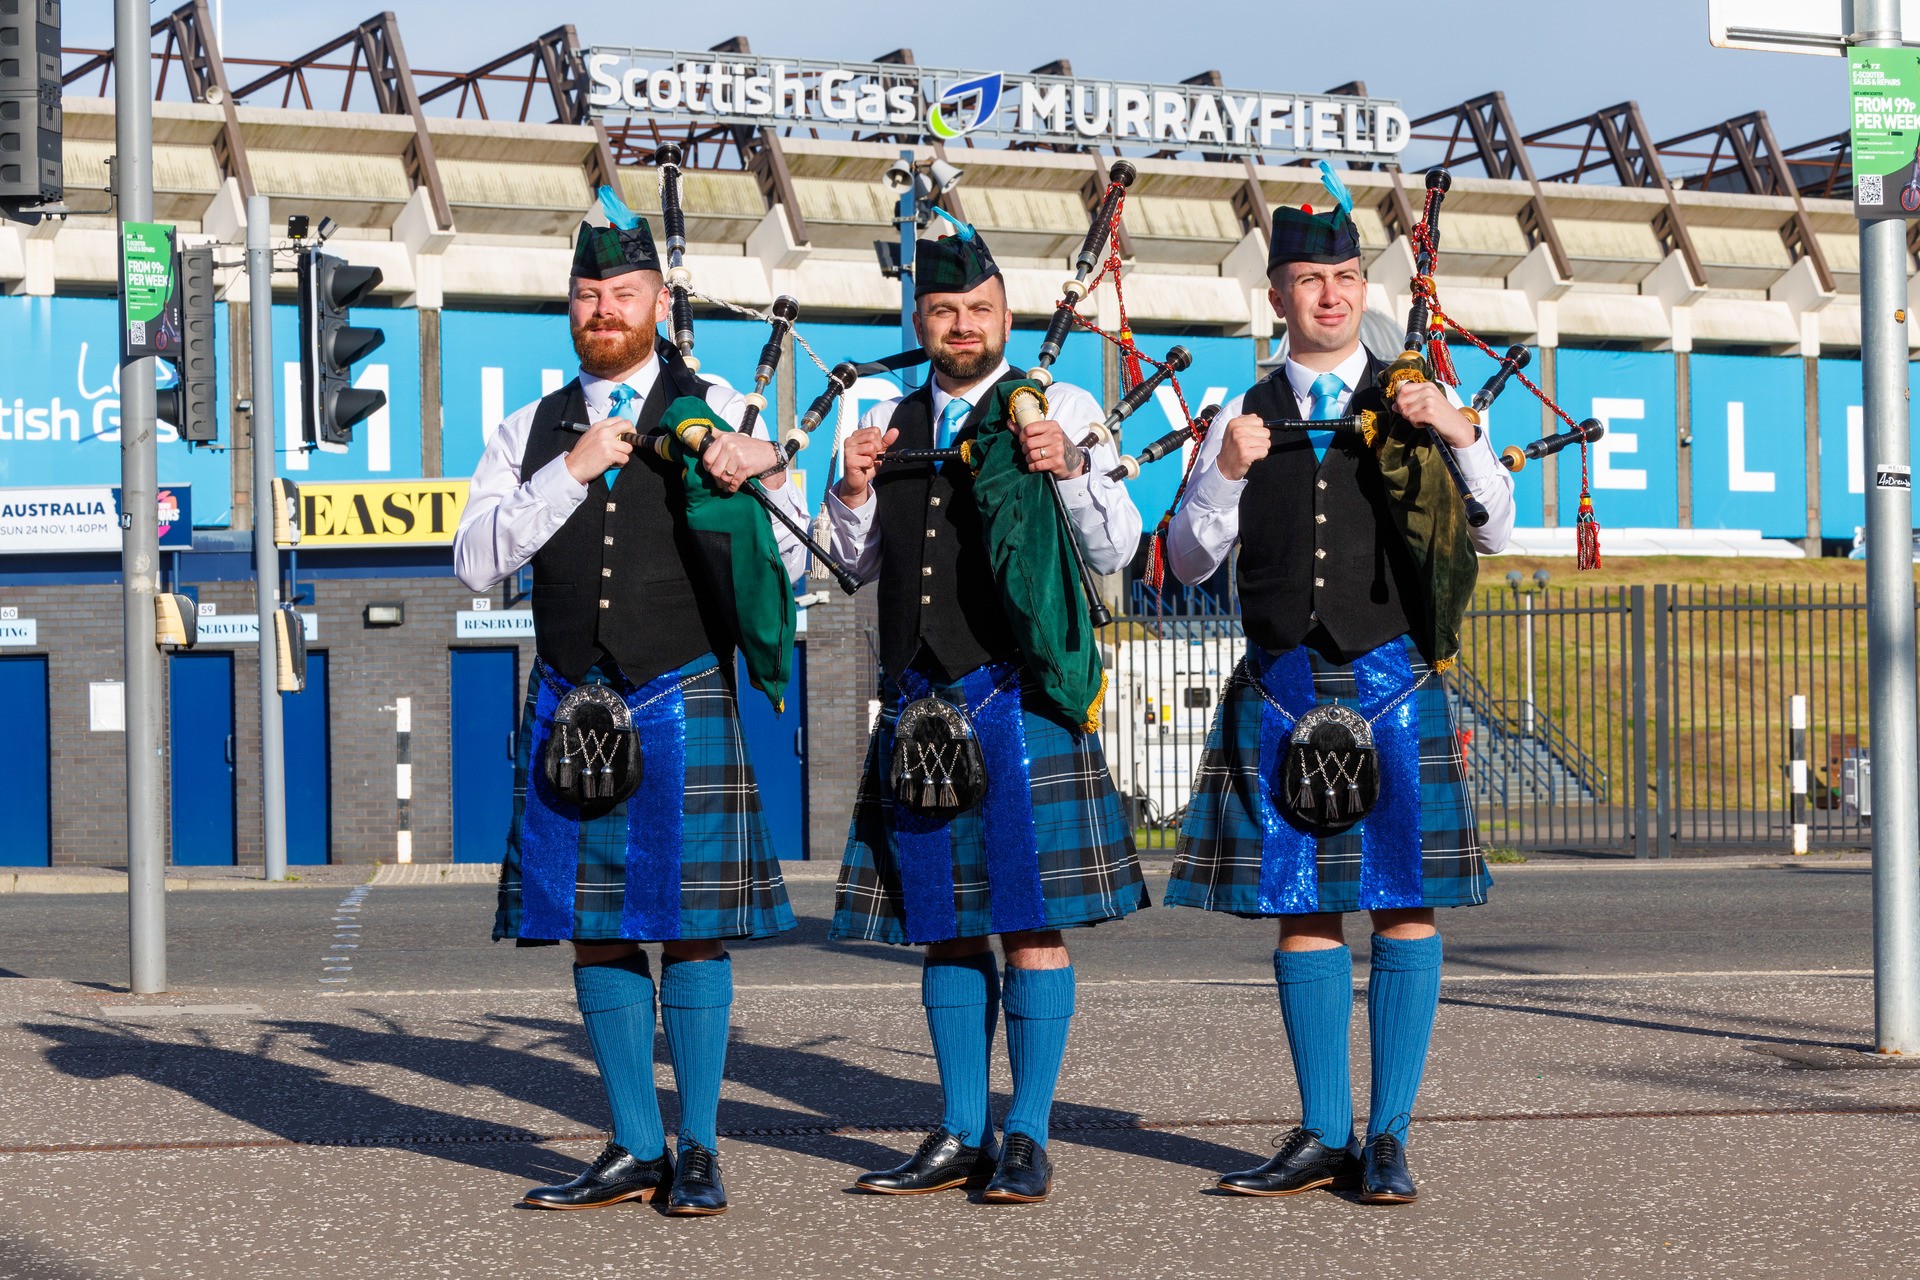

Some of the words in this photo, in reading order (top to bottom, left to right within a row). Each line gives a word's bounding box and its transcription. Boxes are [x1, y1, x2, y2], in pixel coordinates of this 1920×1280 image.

[588, 53, 806, 117] Scottish
[820, 69, 917, 124] Gas
[1854, 96, 1893, 113] FROM
[1894, 97, 1917, 114] 99p
[1020, 80, 1412, 154] MURRAYFIELD
[1855, 113, 1882, 129] PER
[128, 260, 151, 273] FROM
[128, 273, 144, 286] PER
[2, 502, 105, 517] AUSTRALIA
[301, 491, 456, 537] EAST
[0, 526, 23, 536] SUN
[26, 525, 38, 535] 24
[40, 524, 68, 535] NOV,
[70, 523, 108, 534] 1.40PM
[201, 604, 213, 614] 59
[476, 600, 488, 609] 57
[3, 608, 16, 618] 60
[464, 618, 532, 630] RESERVED
